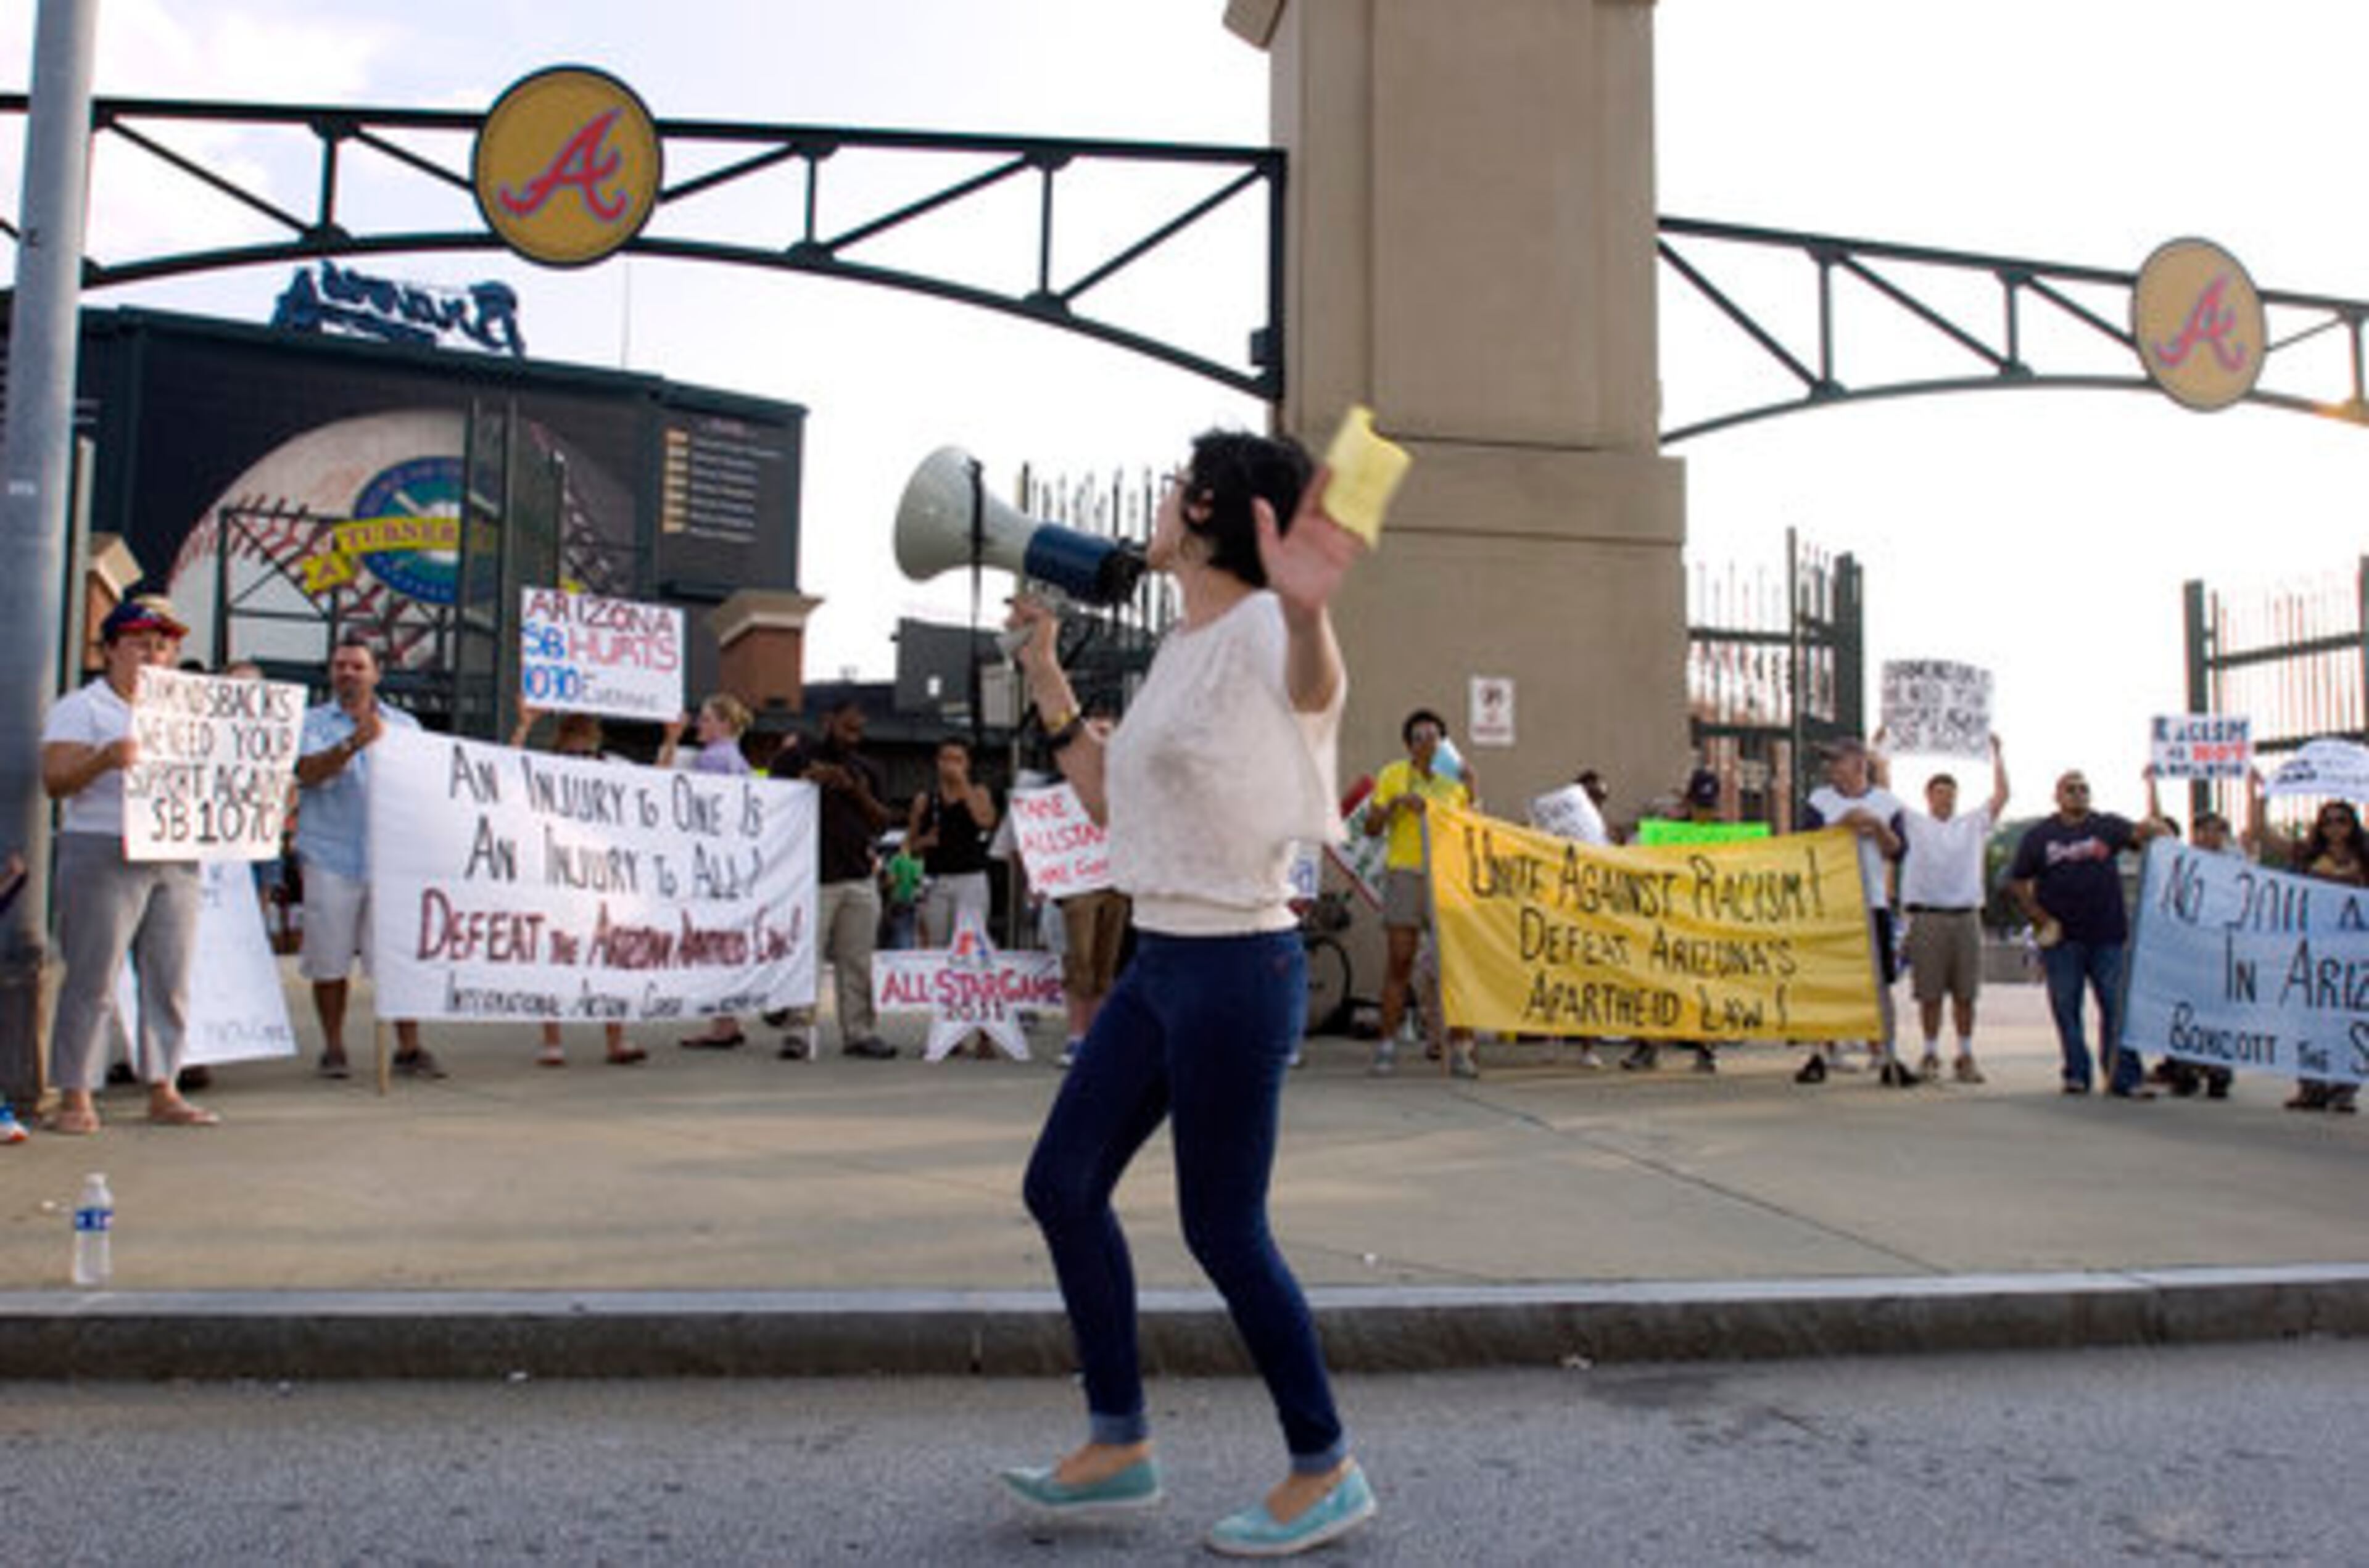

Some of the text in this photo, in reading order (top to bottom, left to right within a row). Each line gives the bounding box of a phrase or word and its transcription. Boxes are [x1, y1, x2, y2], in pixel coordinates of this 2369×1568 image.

[498, 106, 627, 220] A
[2152, 271, 2249, 372] A
[527, 590, 674, 633] ARIZONA
[523, 621, 679, 672] SB HURTS
[231, 722, 294, 762] YOUR
[2152, 717, 2249, 741] RACISM
[2193, 743, 2246, 761] NOT
[151, 798, 276, 845] SB 1070
[450, 744, 500, 803] AN
[521, 755, 626, 827] INJURY
[672, 773, 722, 836] ONE
[739, 782, 764, 838] IS
[464, 814, 517, 883] AN
[544, 825, 639, 897] INJURY
[1463, 826, 1826, 923] UNITE AGAINST RACISM!
[417, 888, 545, 962] DEFEAT
[1519, 907, 1798, 978] DEFEAT ARIZONA'S
[1521, 973, 1682, 1028] APARTHEID
[2225, 931, 2257, 1004] IN
[2169, 1001, 2278, 1065] BOYCOTT
